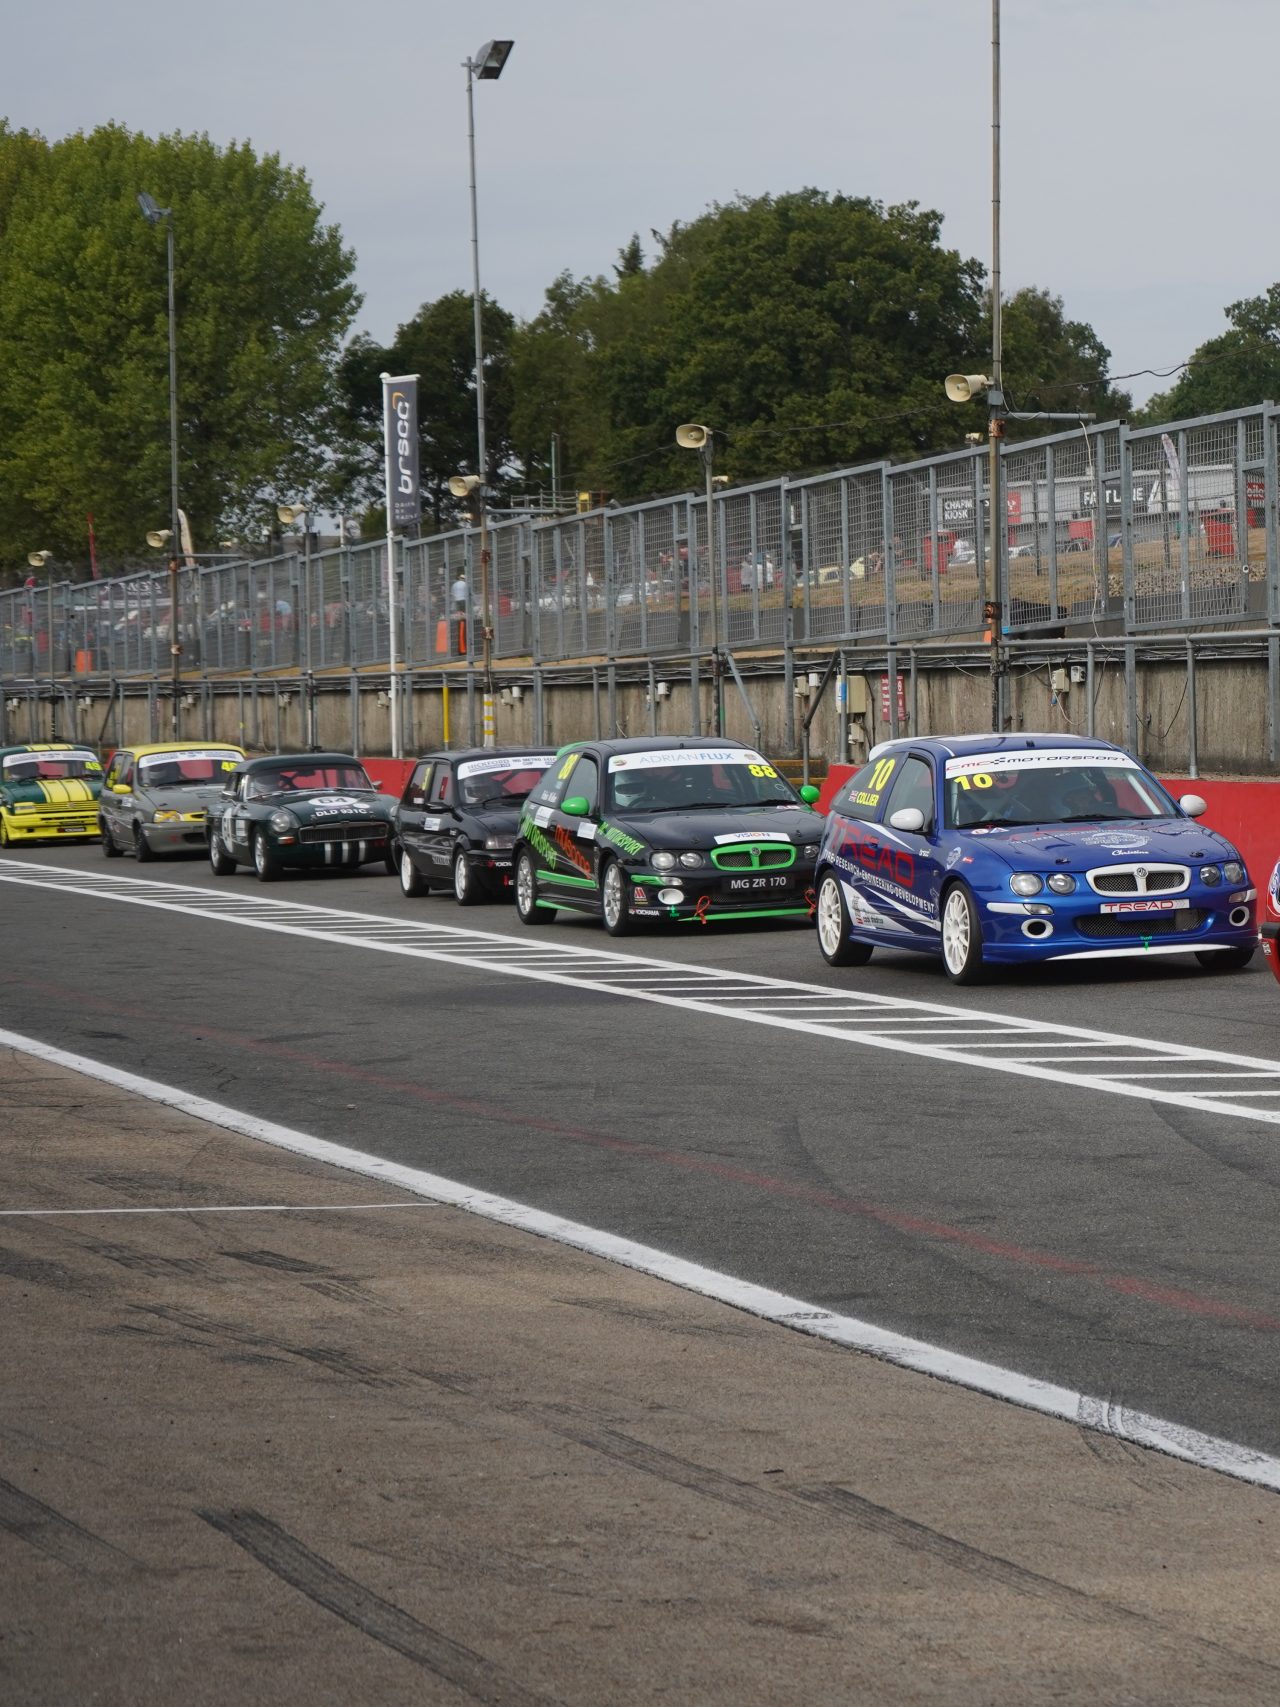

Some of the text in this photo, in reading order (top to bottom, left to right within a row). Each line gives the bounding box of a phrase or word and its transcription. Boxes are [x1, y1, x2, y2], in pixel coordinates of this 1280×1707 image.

[397, 401, 413, 494] brscc
[747, 764, 778, 779] 88
[868, 758, 896, 791] 10
[953, 773, 993, 791] 10
[856, 791, 880, 806] COLLIER
[315, 809, 338, 817] DLD
[730, 877, 787, 889] MG ZR 170
[1104, 900, 1174, 912] TREAD
